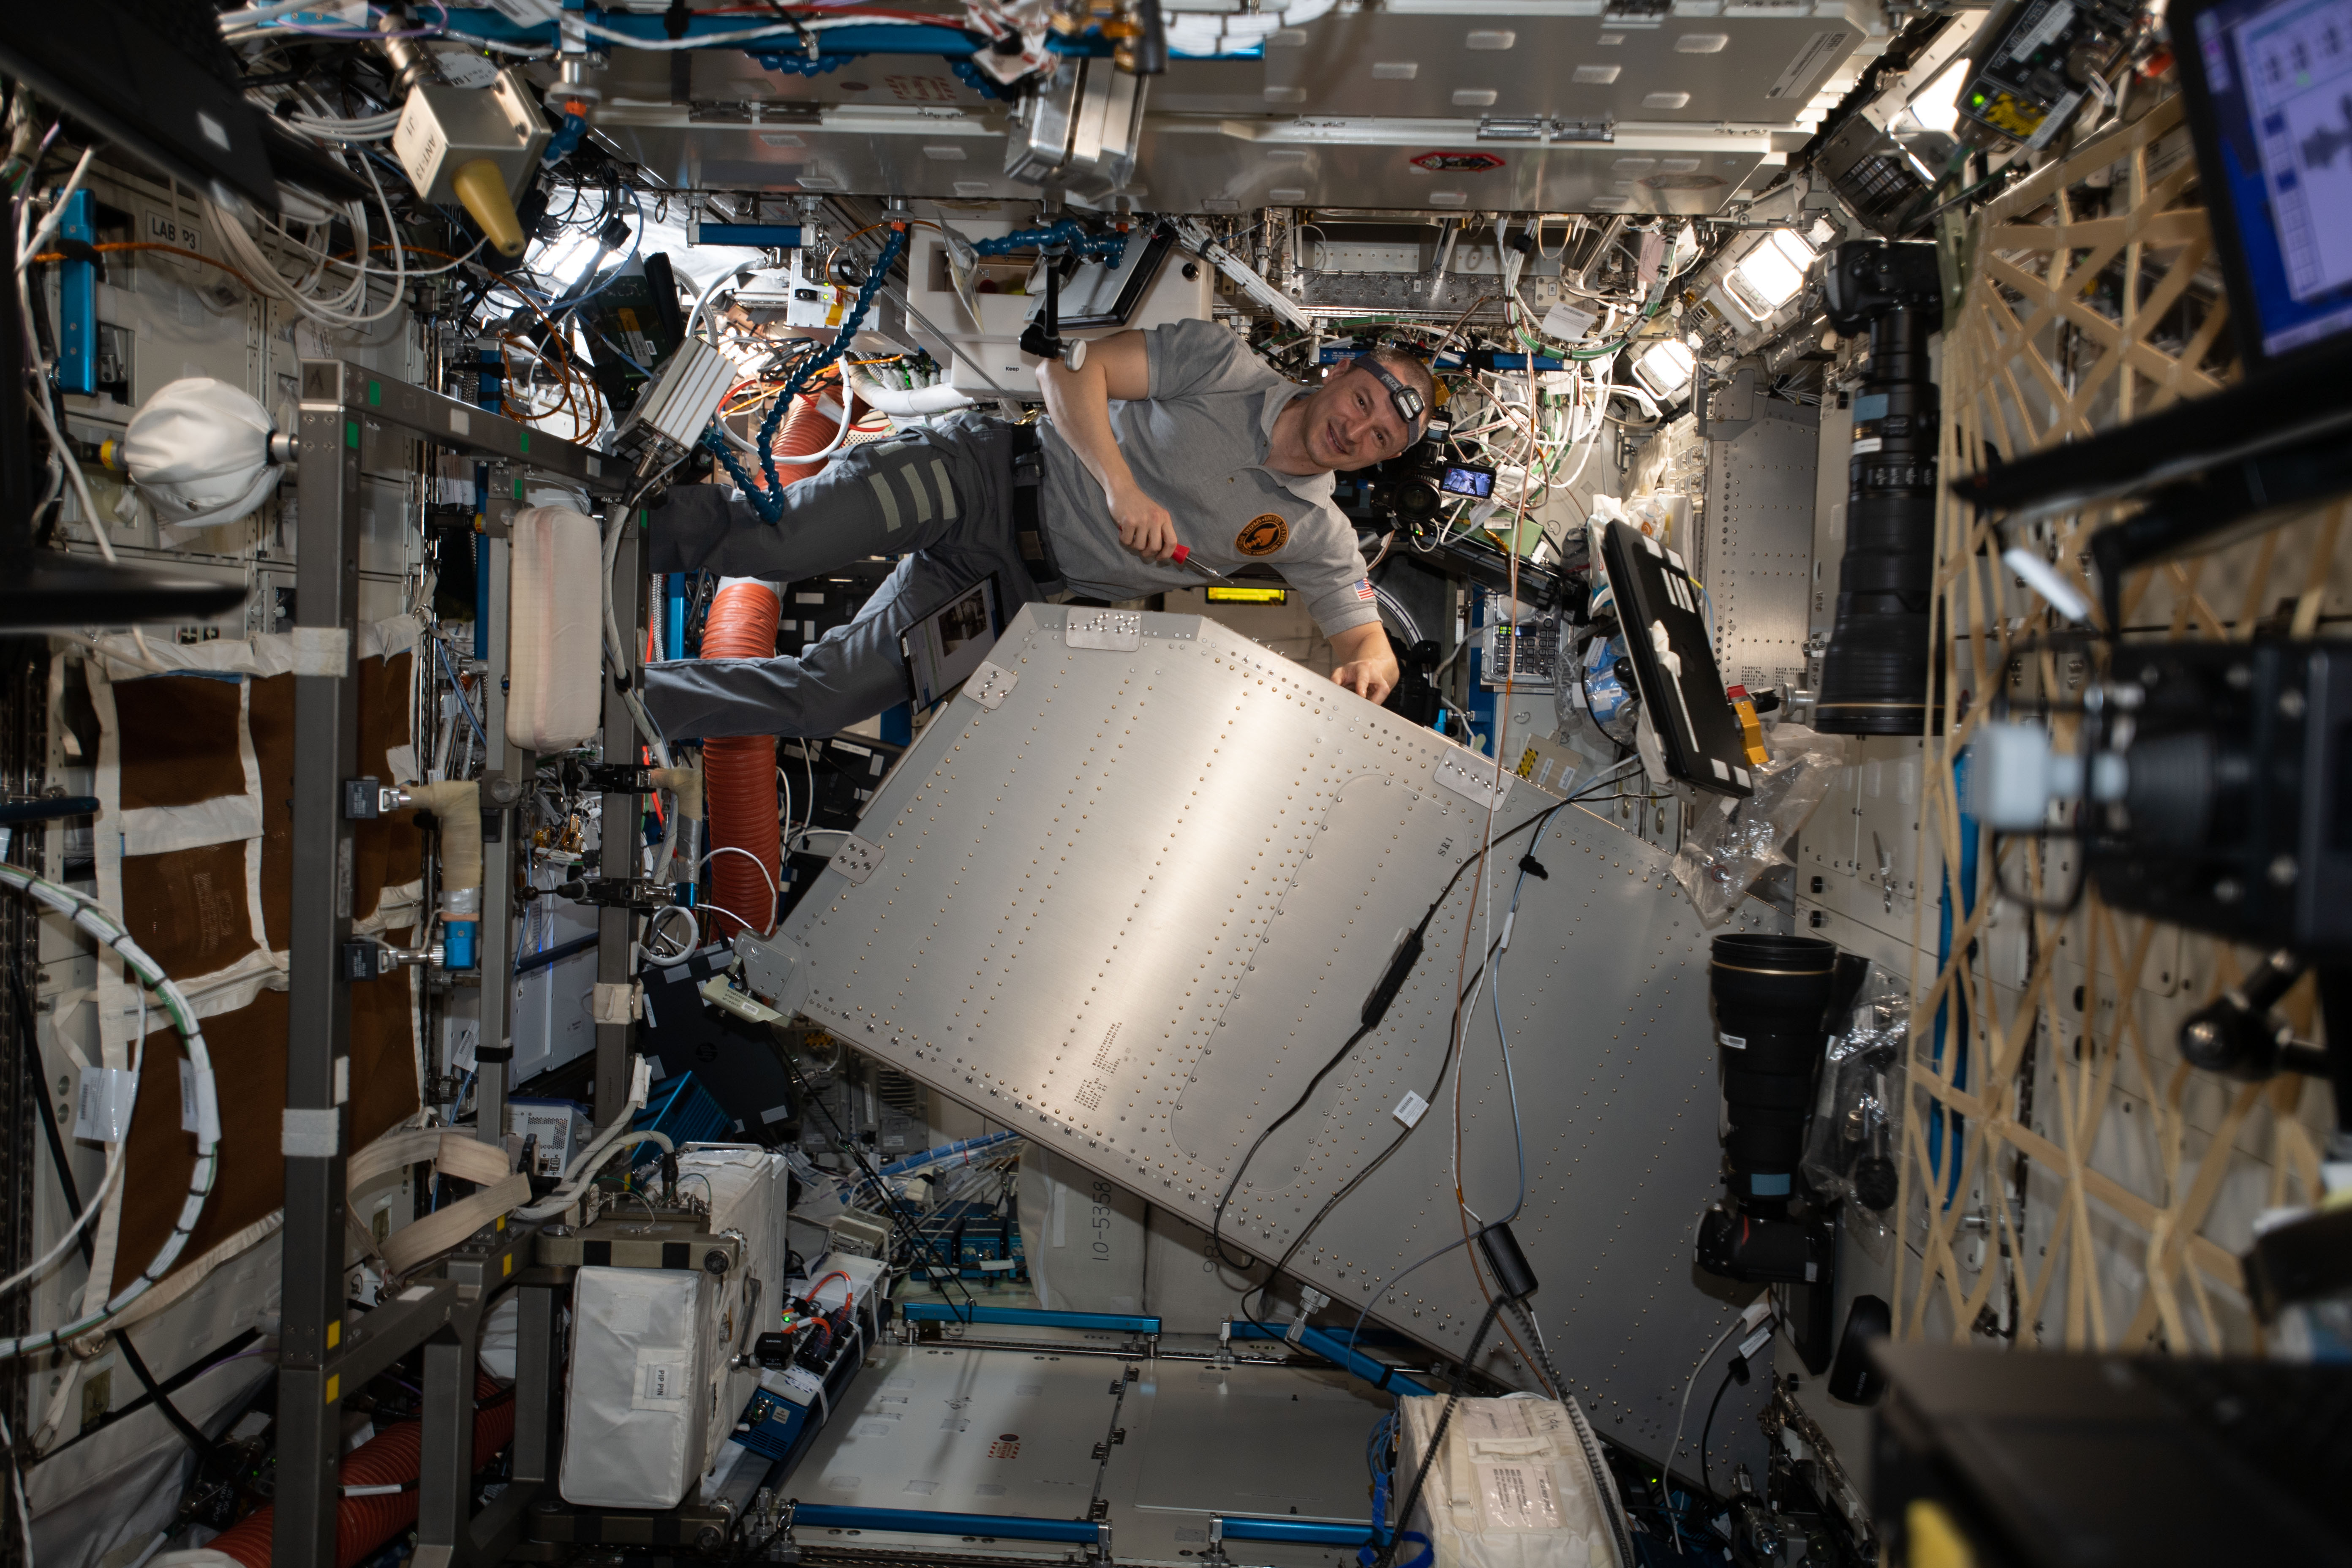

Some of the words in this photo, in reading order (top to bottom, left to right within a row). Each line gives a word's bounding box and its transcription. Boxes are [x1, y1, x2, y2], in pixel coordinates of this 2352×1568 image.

[406, 116, 415, 136] J1
[152, 218, 196, 249] LABP3
[1382, 373, 1401, 391] PETZL
[1244, 519, 1262, 534] SPECIAL
[1264, 516, 1281, 524] UNITED
[1253, 544, 1278, 555] COMMAND
[1437, 837, 1454, 857] SR1
[1074, 1079, 1087, 1102] PRODUCT
[1099, 1023, 1116, 1052] STRUCTURE
[1078, 1091, 1087, 1105] PART
[1083, 1087, 1095, 1107] SERIAL
[657, 1384, 665, 1396] PIN
[212, 1501, 222, 1522] INPUT
[222, 1501, 230, 1513] VDC
